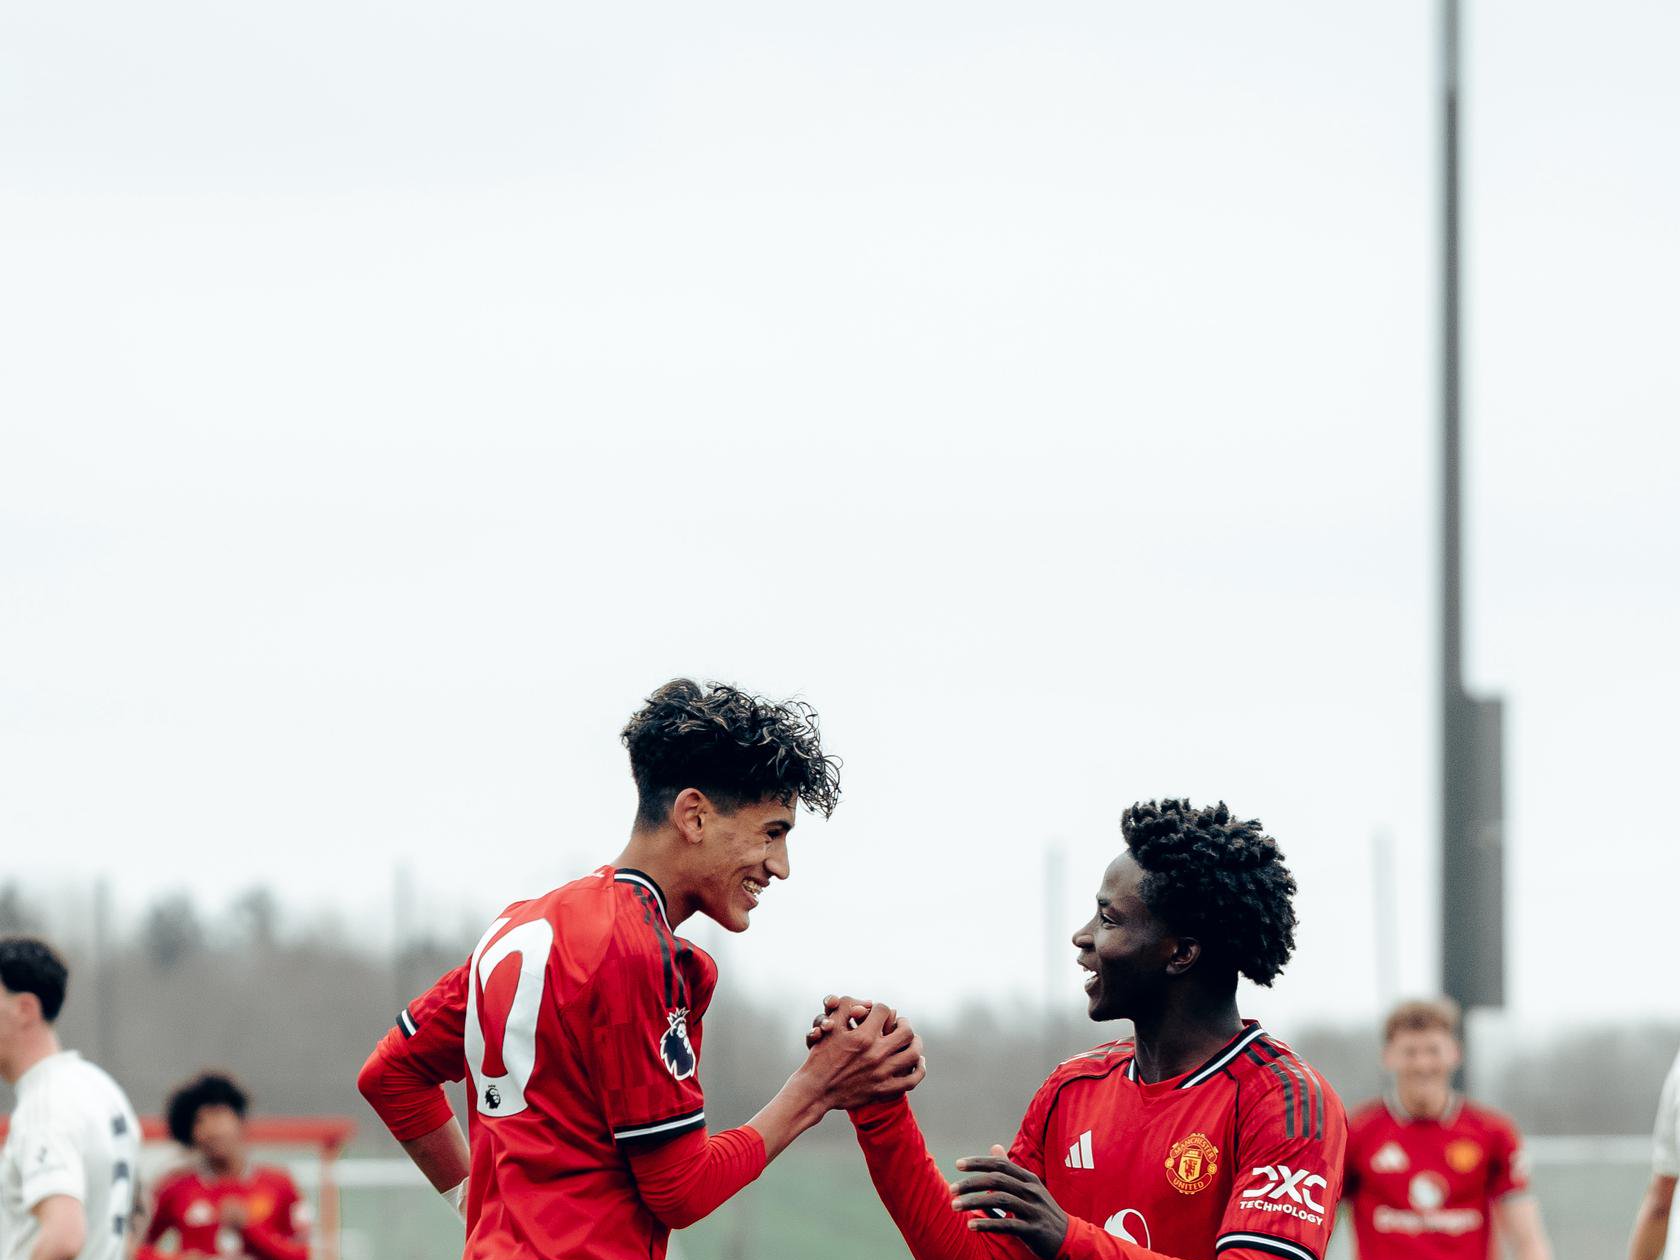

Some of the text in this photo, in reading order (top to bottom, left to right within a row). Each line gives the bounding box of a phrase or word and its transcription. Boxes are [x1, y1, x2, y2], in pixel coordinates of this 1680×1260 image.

[1173, 1137, 1214, 1160] MANCHESTER
[1173, 1177, 1204, 1191] UNITED
[1242, 1165, 1328, 1215] DXC
[1240, 1200, 1323, 1226] TECHNOLOGY
